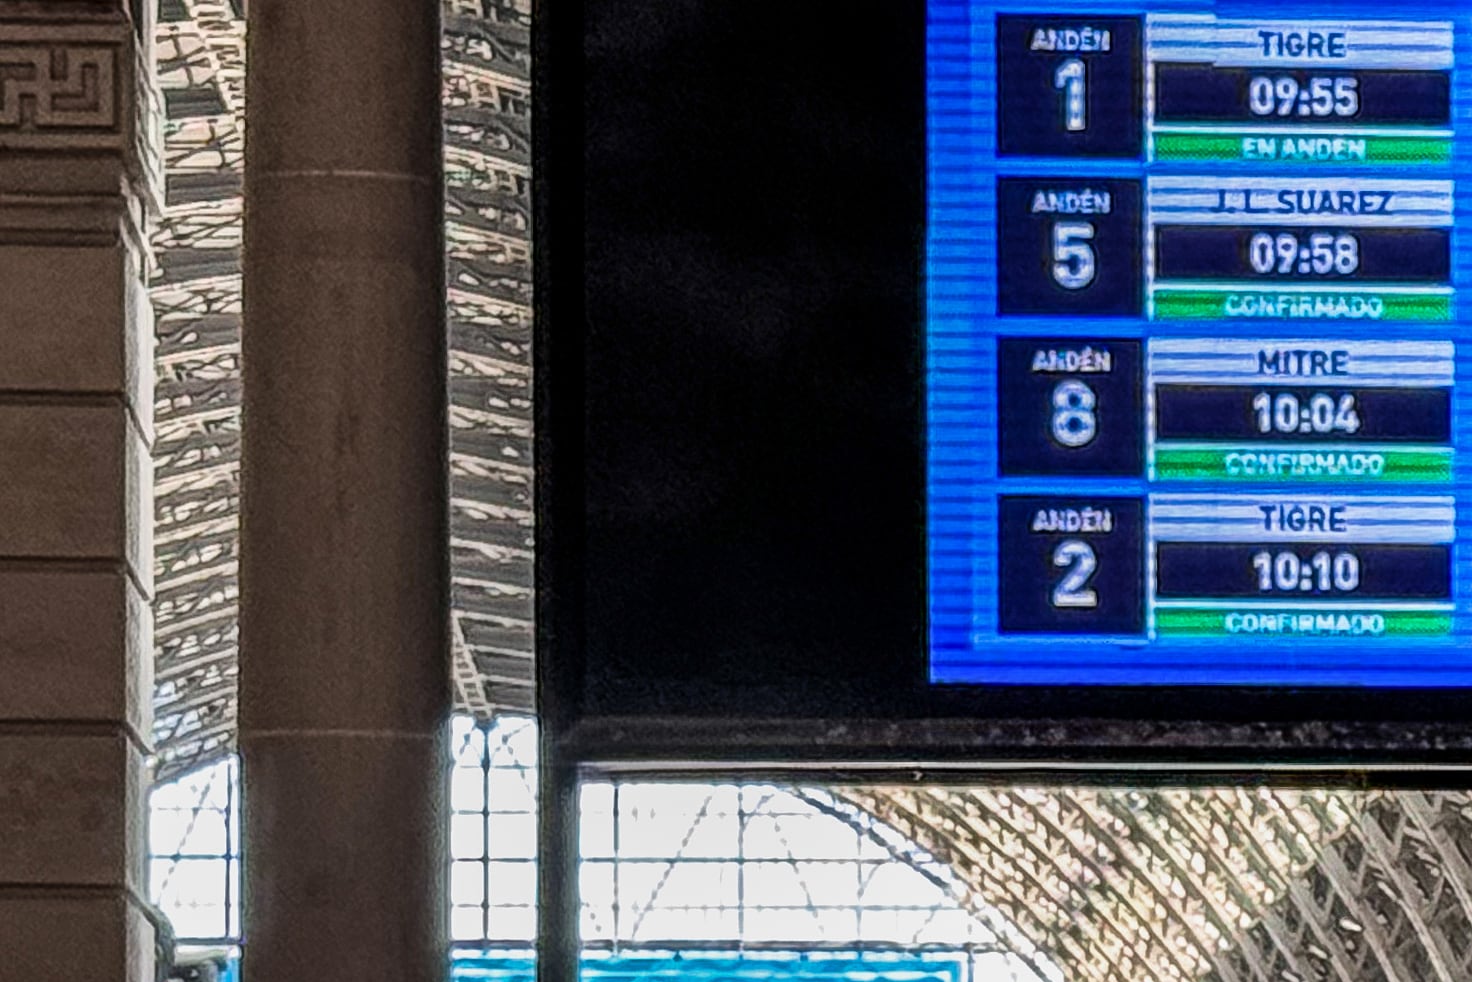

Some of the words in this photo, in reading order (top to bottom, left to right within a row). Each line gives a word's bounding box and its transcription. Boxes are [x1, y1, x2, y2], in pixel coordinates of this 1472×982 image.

[1258, 30, 1347, 58] TIGRE
[1054, 59, 1086, 131] 1
[1249, 76, 1359, 116] 09:55
[1243, 138, 1276, 159] EN
[1033, 188, 1110, 213] ANDÉN
[1052, 221, 1095, 288] 5
[1249, 232, 1359, 275] 09:58
[1224, 294, 1384, 319] CONFIRMADO
[1259, 350, 1348, 376] MITRE
[1052, 380, 1096, 446] 8
[1253, 393, 1360, 433] 10:04
[1225, 453, 1383, 475] CONFIRMADO
[1259, 506, 1347, 533] TIGRE
[1052, 540, 1097, 607] 2
[1253, 552, 1359, 590] 10:10
[1225, 613, 1383, 634] CONFIRMADO
